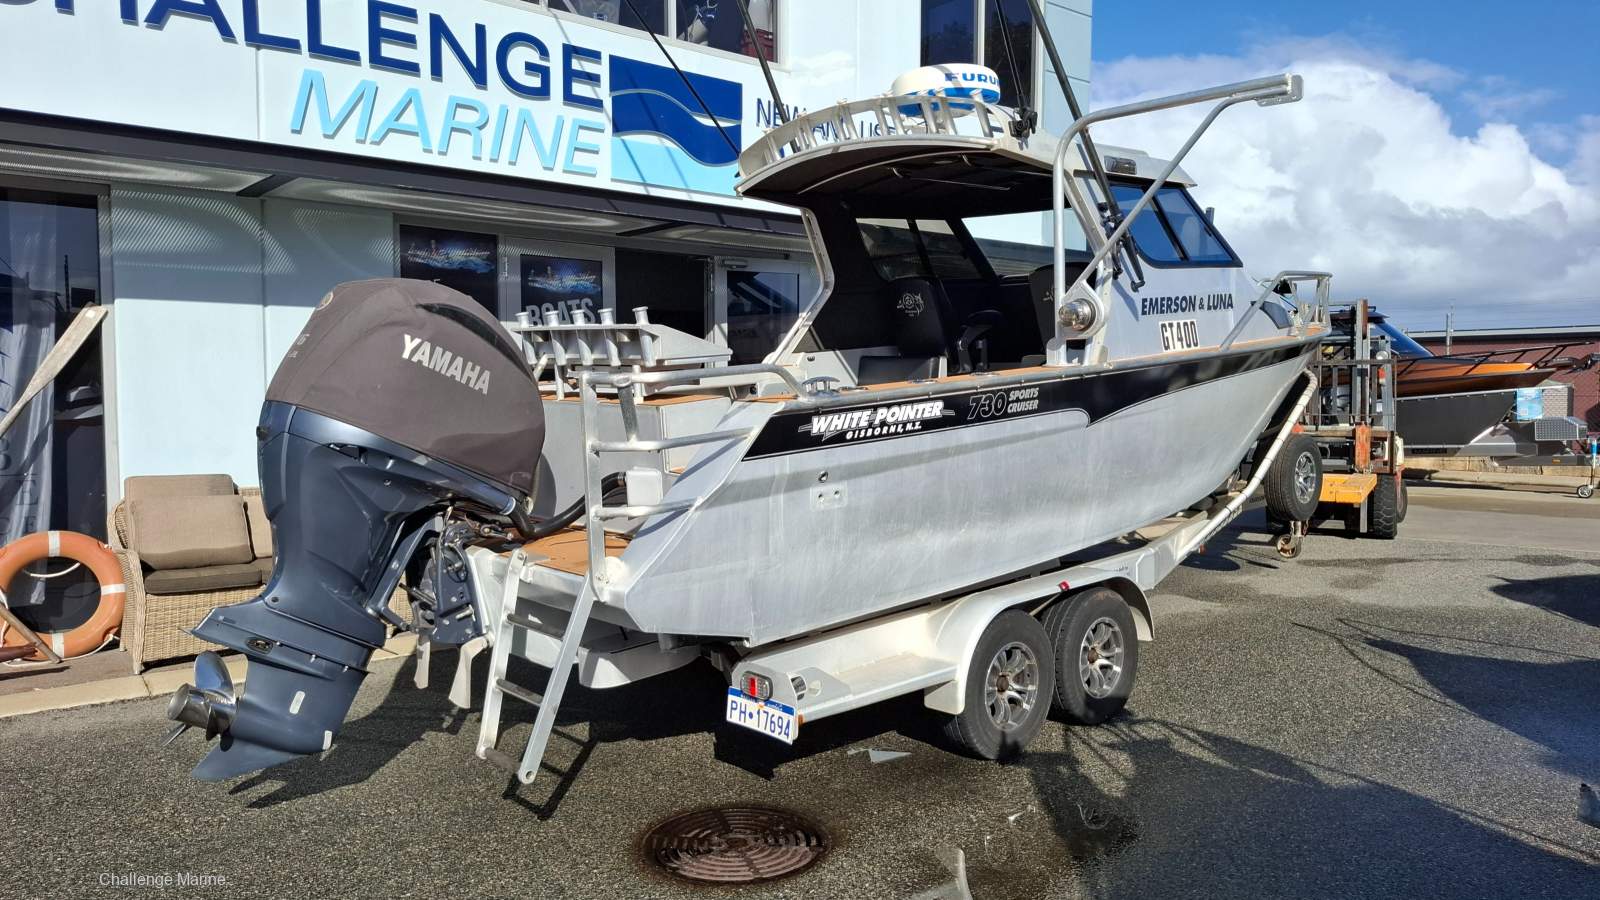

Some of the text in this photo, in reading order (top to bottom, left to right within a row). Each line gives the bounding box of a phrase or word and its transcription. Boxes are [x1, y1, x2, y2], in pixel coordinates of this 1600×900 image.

[0, 0, 603, 112] ALLENGE
[945, 72, 999, 85] FURU
[291, 69, 605, 176] MARINE
[1141, 293, 1234, 316] EMERSON & LUNA
[1160, 320, 1199, 351] GT400
[402, 333, 492, 396] YAMAHA
[967, 391, 1007, 420] 730
[1007, 399, 1039, 414] CRUISER
[1009, 387, 1039, 402] SPORTS
[811, 400, 944, 435] WHITE POINTER
